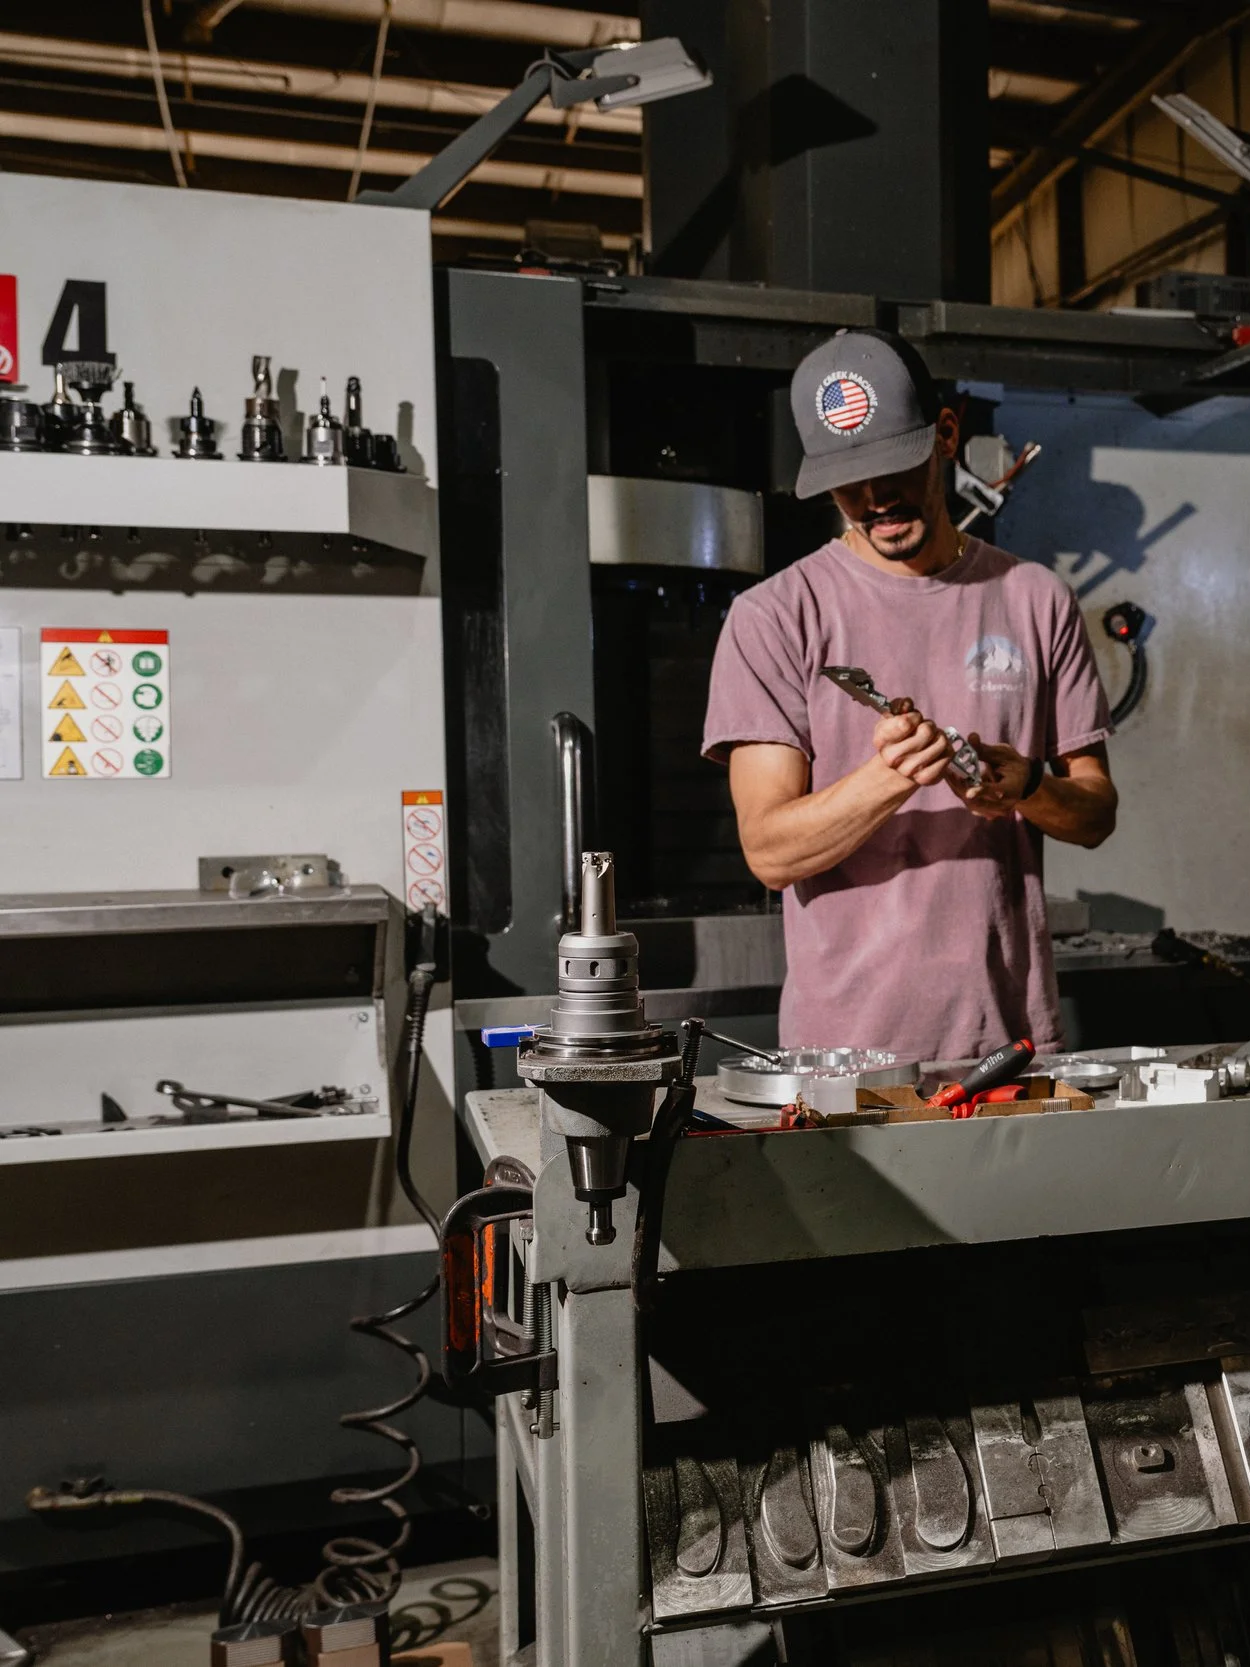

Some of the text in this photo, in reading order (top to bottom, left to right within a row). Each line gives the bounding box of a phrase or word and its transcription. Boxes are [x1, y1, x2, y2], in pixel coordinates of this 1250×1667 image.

[42, 279, 116, 369] 4
[822, 371, 848, 387] CREEK
[848, 371, 878, 407] MACHINE
[979, 1051, 1004, 1073] wiha
